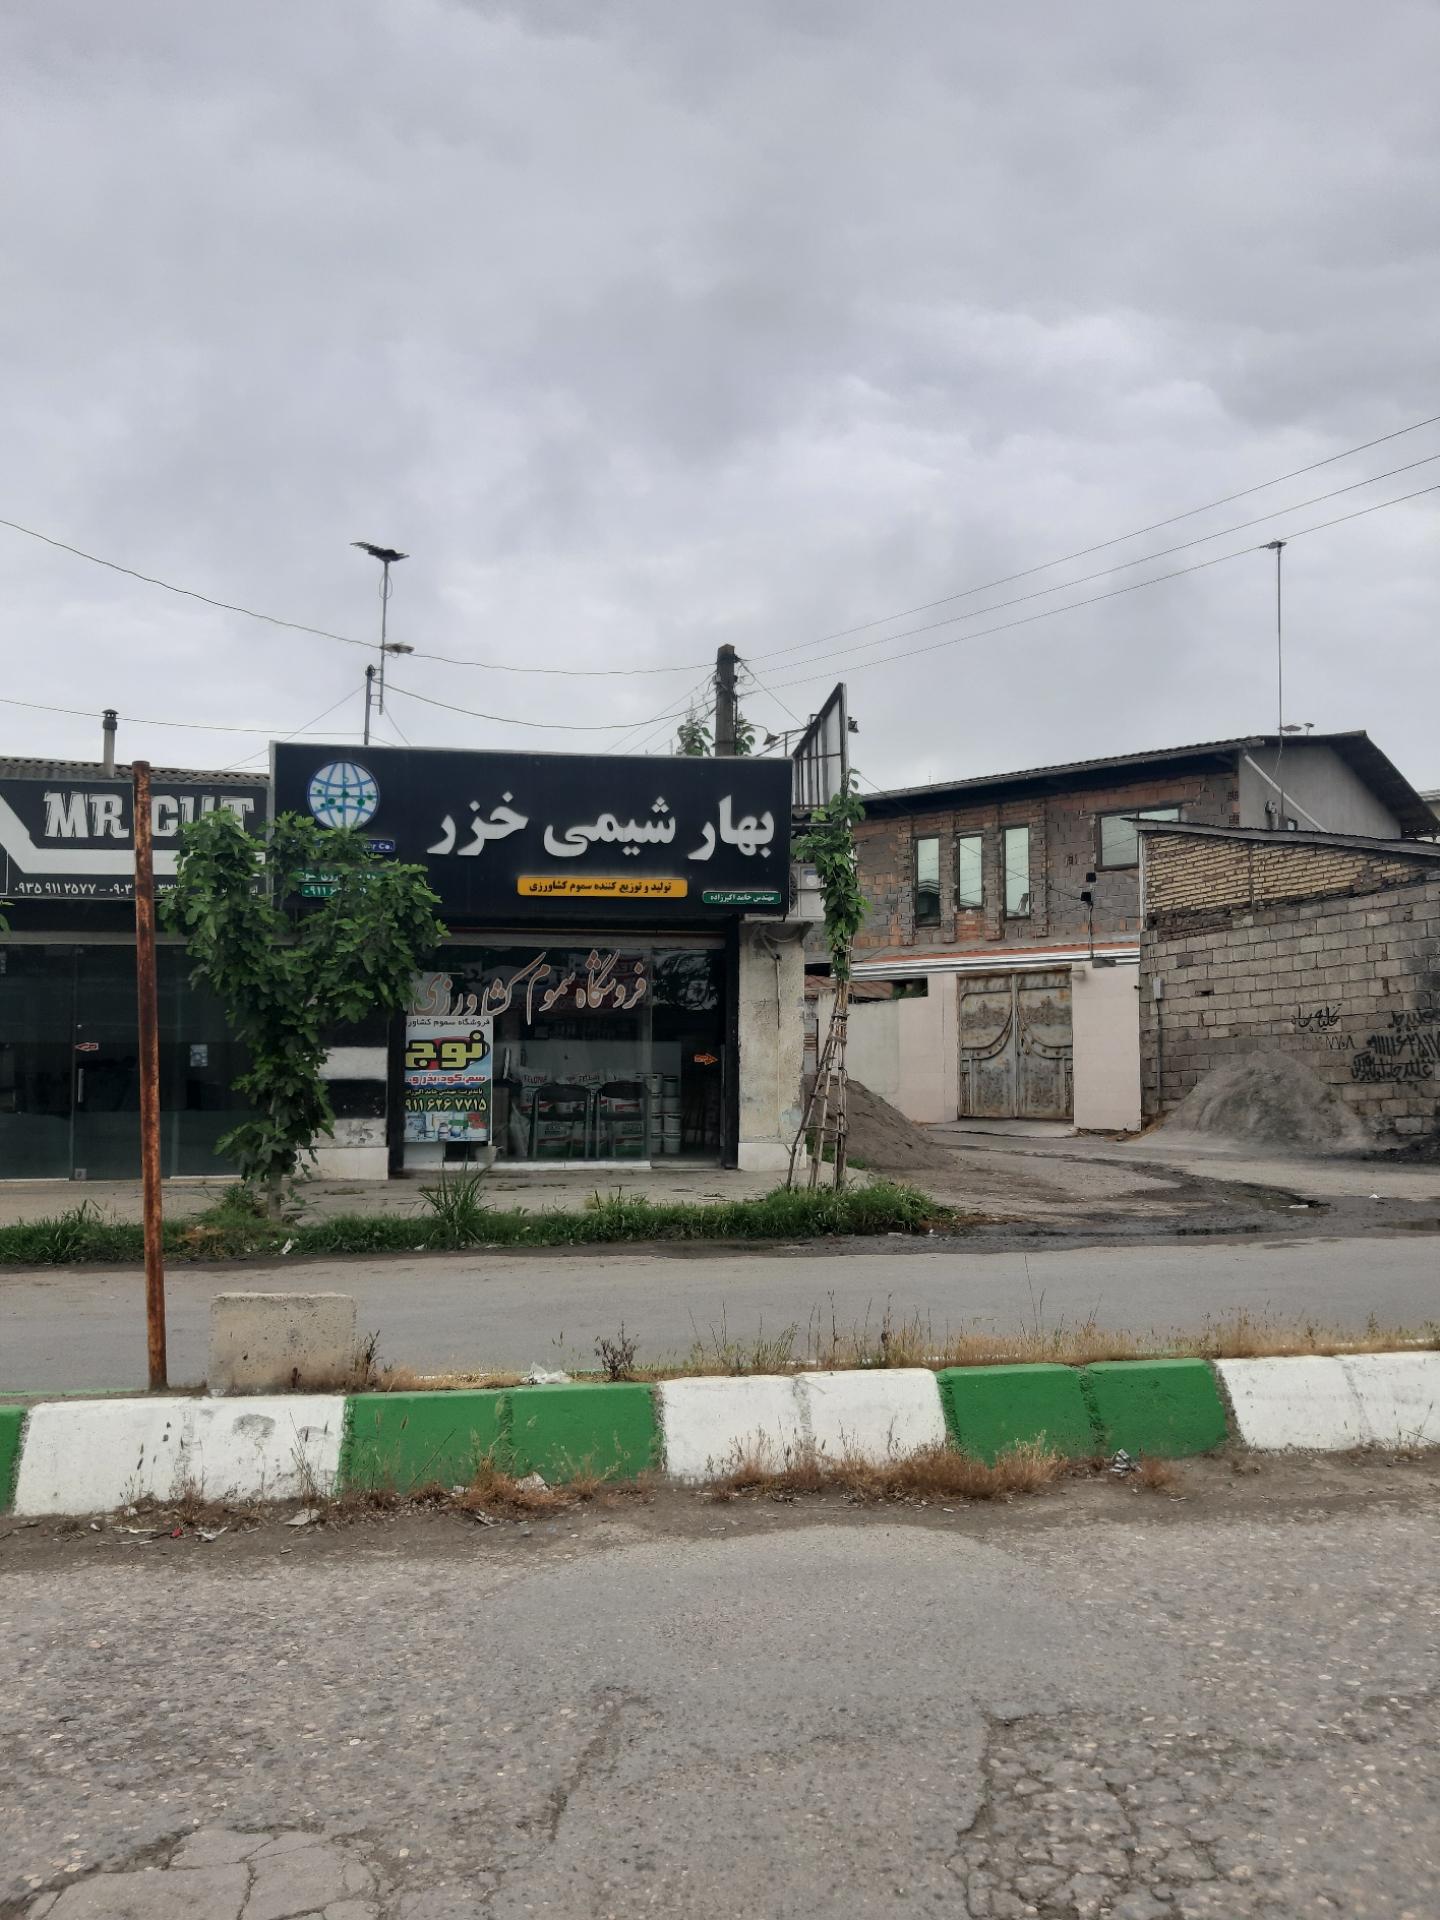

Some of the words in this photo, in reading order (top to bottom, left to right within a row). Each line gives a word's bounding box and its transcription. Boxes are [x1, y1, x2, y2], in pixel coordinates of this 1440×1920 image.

[43, 791, 129, 839] MR
[151, 794, 254, 837] CUT
[427, 791, 529, 857] خزر
[544, 796, 676, 858] شیمی
[688, 794, 775, 861] بهار
[14, 882, 42, 894] ۰۹۳۵
[45, 882, 64, 895] ۹۱۱
[65, 883, 97, 896] ۲۵۷۷
[529, 880, 567, 893] کشاورزی
[569, 883, 593, 893] سموم
[594, 880, 617, 892] کننده
[619, 882, 643, 894] توزیع
[644, 884, 650, 894] و
[650, 882, 673, 894] تولید
[576, 949, 647, 1010] فروشگاه
[525, 964, 576, 1026] سموم
[458, 1018, 490, 1028] فروشگاه
